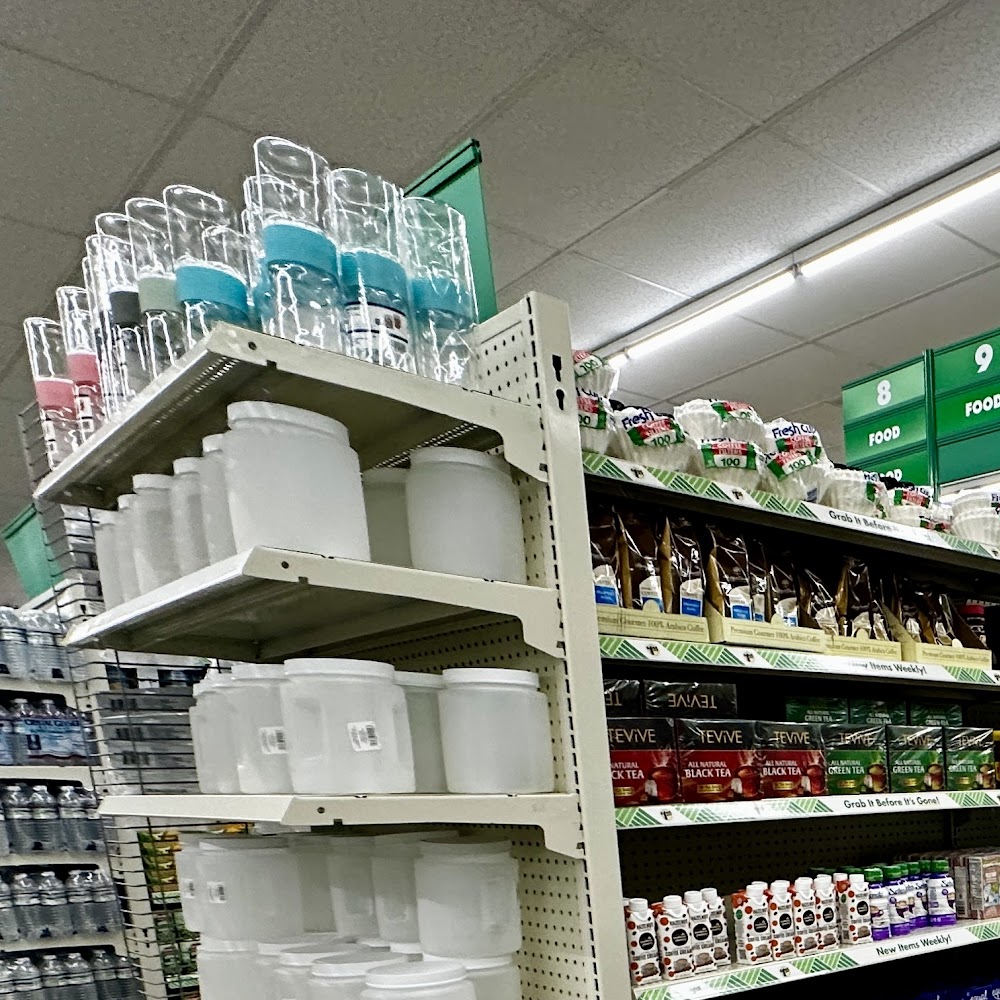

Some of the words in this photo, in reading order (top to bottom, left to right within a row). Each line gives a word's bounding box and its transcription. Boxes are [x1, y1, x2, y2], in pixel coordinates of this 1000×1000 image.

[974, 343, 994, 373] 9
[877, 379, 892, 406] 8
[622, 407, 654, 430] Fresh
[772, 422, 801, 438] Fresh
[868, 426, 900, 447] FOOD
[720, 458, 740, 466] 100
[788, 459, 806, 470] 100
[829, 510, 852, 522] Grab
[854, 516, 862, 526] It
[869, 662, 892, 672] Items
[894, 664, 928, 676] Weekly!
[625, 770, 644, 779] TEA
[685, 769, 714, 778] BLACK
[715, 768, 731, 778] TEA
[763, 767, 786, 776] BLACK
[787, 767, 801, 775] TEA
[852, 766, 864, 774] TEA
[893, 766, 912, 774] GREEN
[844, 798, 866, 809] Grab
[868, 798, 874, 807] It
[876, 798, 902, 807] Before
[904, 797, 915, 805] It's
[917, 796, 940, 805] Gone!
[876, 945, 896, 956] New
[898, 942, 920, 953] Items
[920, 935, 952, 949] Weekly!
